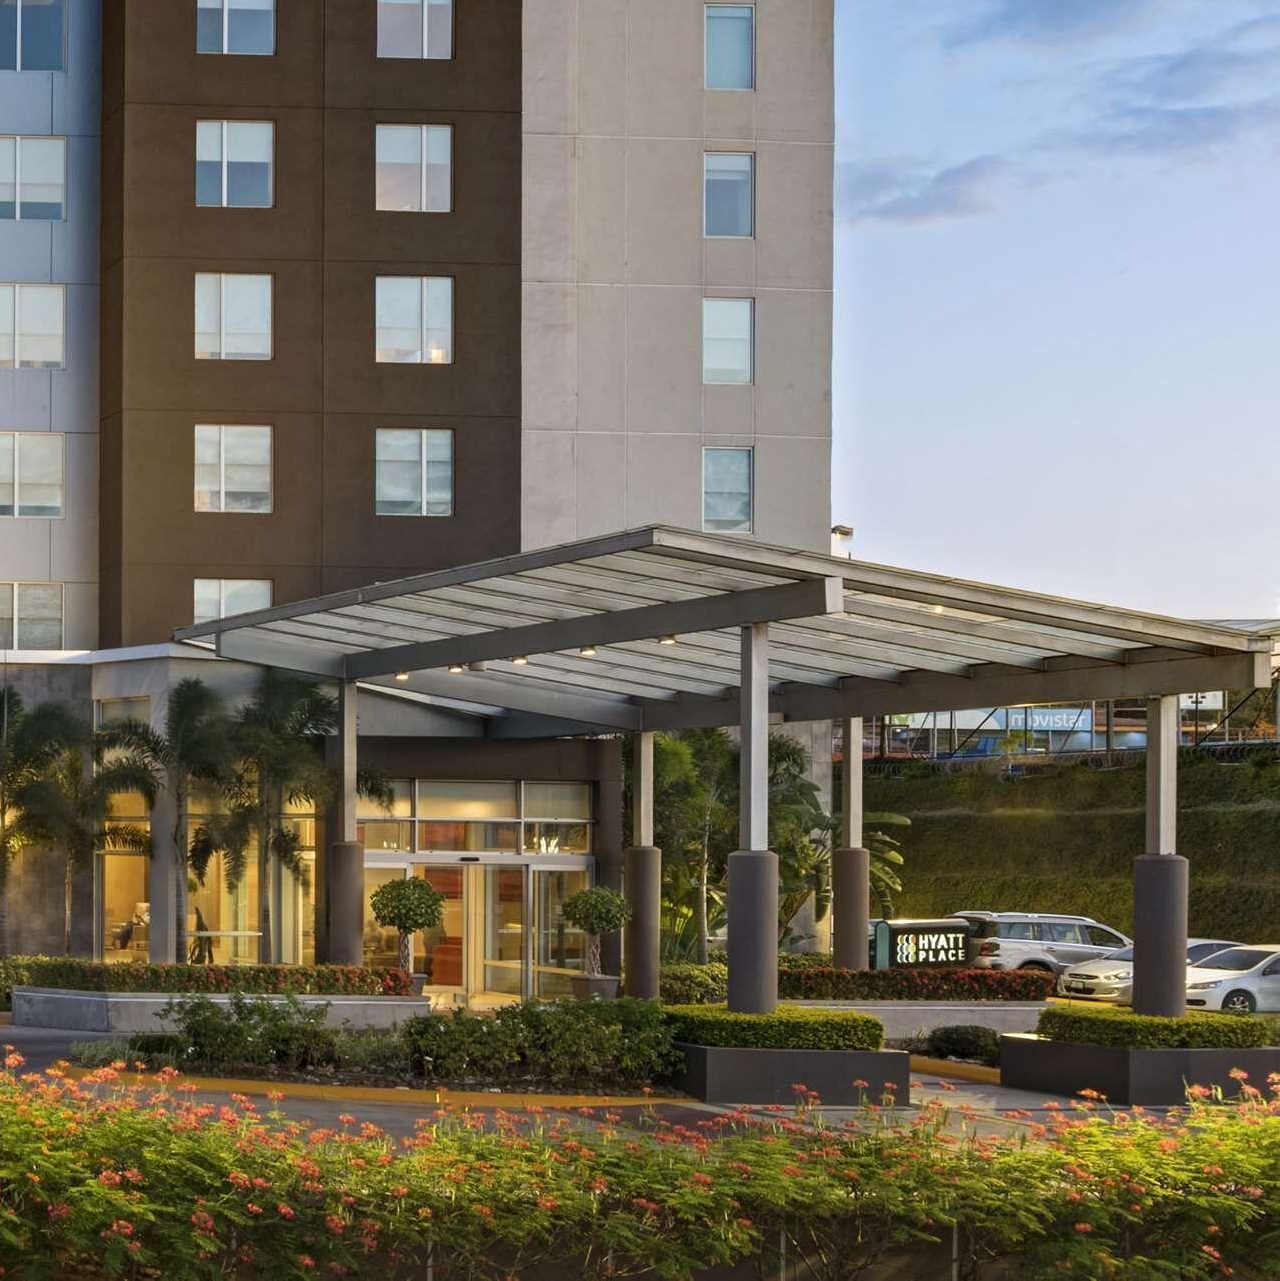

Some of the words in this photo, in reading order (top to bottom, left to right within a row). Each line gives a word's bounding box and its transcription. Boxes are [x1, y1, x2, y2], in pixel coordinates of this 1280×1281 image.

[1011, 712, 1086, 728] movistar
[918, 934, 965, 949] HYATT
[918, 950, 965, 962] PLACE
